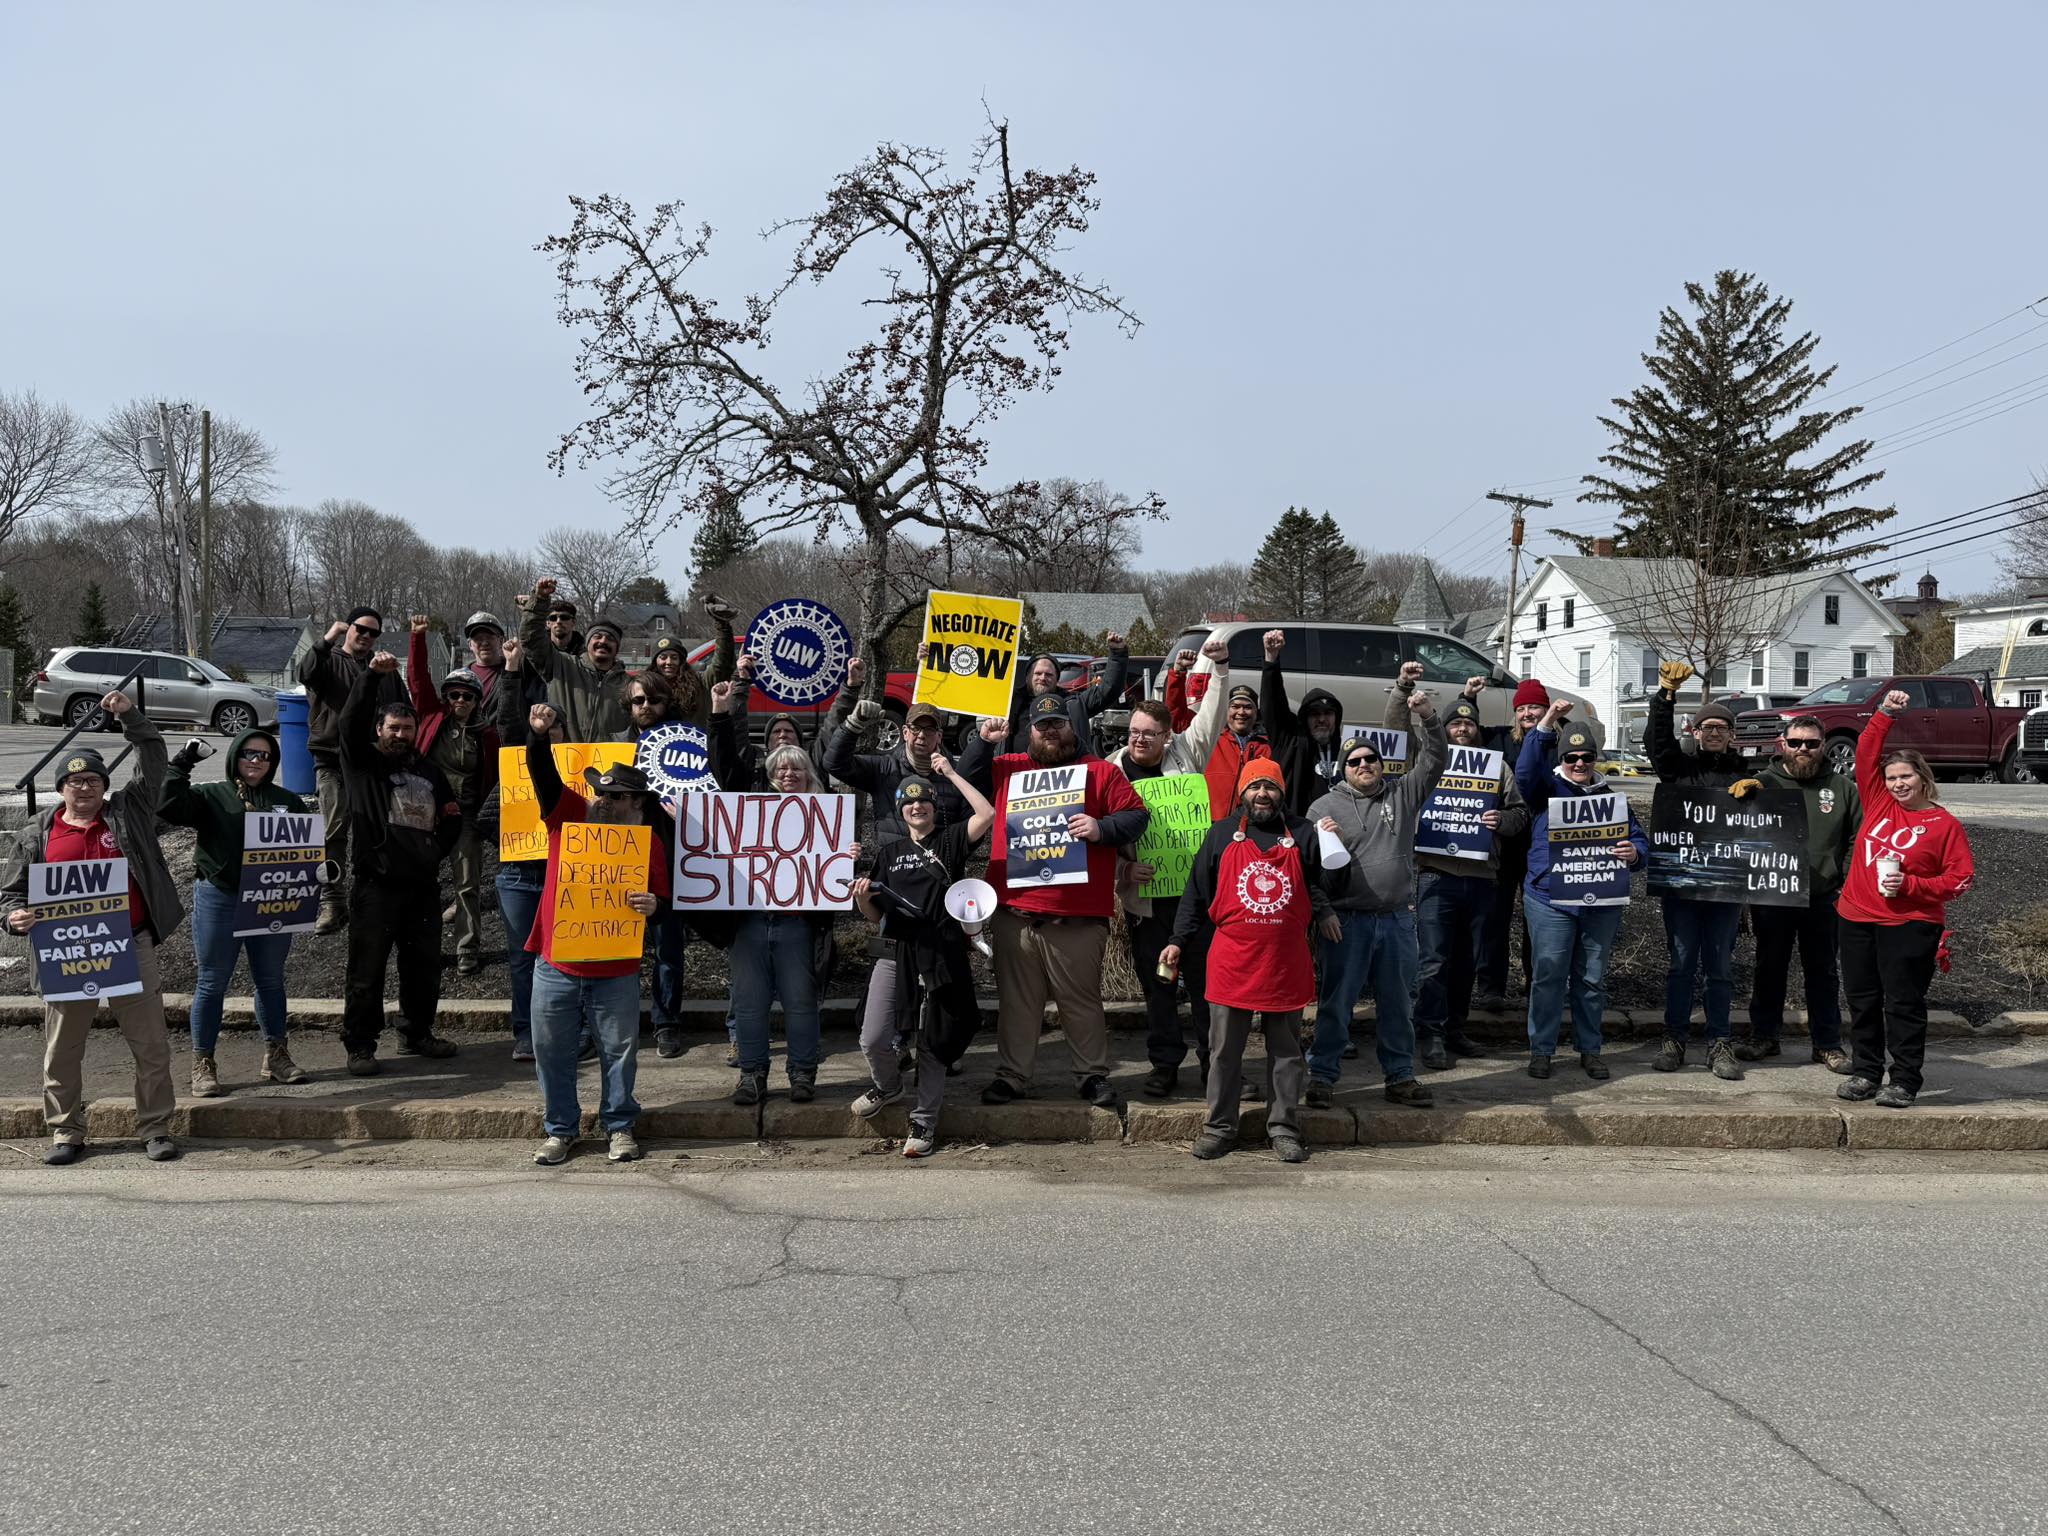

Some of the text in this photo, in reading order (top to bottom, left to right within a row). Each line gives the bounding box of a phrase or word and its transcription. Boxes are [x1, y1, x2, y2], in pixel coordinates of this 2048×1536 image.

[931, 613, 1017, 643] NEGOTIATE
[775, 636, 821, 668] UAW
[663, 748, 708, 771] UAW
[1388, 763, 1402, 772] UP
[1021, 768, 1075, 794] UAW
[1439, 778, 1494, 791] TAND UP
[1011, 793, 1080, 811] STAND UP
[1433, 796, 1485, 809] SAVING
[1562, 796, 1615, 824] UAW
[680, 792, 844, 855] UNION
[1022, 813, 1068, 830] COLA
[1157, 802, 1185, 826] FAIR
[1187, 801, 1209, 826] PAY
[1421, 809, 1484, 824] AMERICA
[1683, 800, 1783, 828] YOU WOULDN'T
[259, 816, 312, 843] UAW
[1431, 821, 1479, 835] DREAM
[1553, 827, 1625, 840] STAND UP
[502, 831, 548, 855] AFFORD
[566, 824, 640, 856] BMDA
[1010, 831, 1079, 849] FAIR PA
[1137, 830, 1164, 850] AND
[1165, 828, 1209, 850] BENEFIT
[1654, 831, 1694, 846] UNDER
[248, 850, 321, 862] STAND UP
[1025, 845, 1067, 862] NOW
[1562, 846, 1616, 857] SAVING
[1679, 843, 1799, 872] PAY FOR UNION
[559, 860, 646, 886] DESERVES
[1176, 854, 1193, 873] OU
[1552, 860, 1627, 872] AMERICAN
[45, 862, 113, 896] UAW
[260, 870, 308, 884] COLA
[677, 851, 854, 906] STRONG
[1563, 871, 1615, 884] DREAM
[1747, 871, 1800, 894] LABOR
[241, 884, 319, 902] FAIR PAY
[560, 887, 575, 911] A
[34, 898, 123, 919] STAND UP
[256, 899, 301, 914] NOW
[553, 919, 642, 940] CONTRACT
[1244, 916, 1268, 925] LOCAL
[52, 922, 111, 941] COLA
[39, 938, 129, 962] FAIR PAY
[61, 956, 113, 976] NOW
